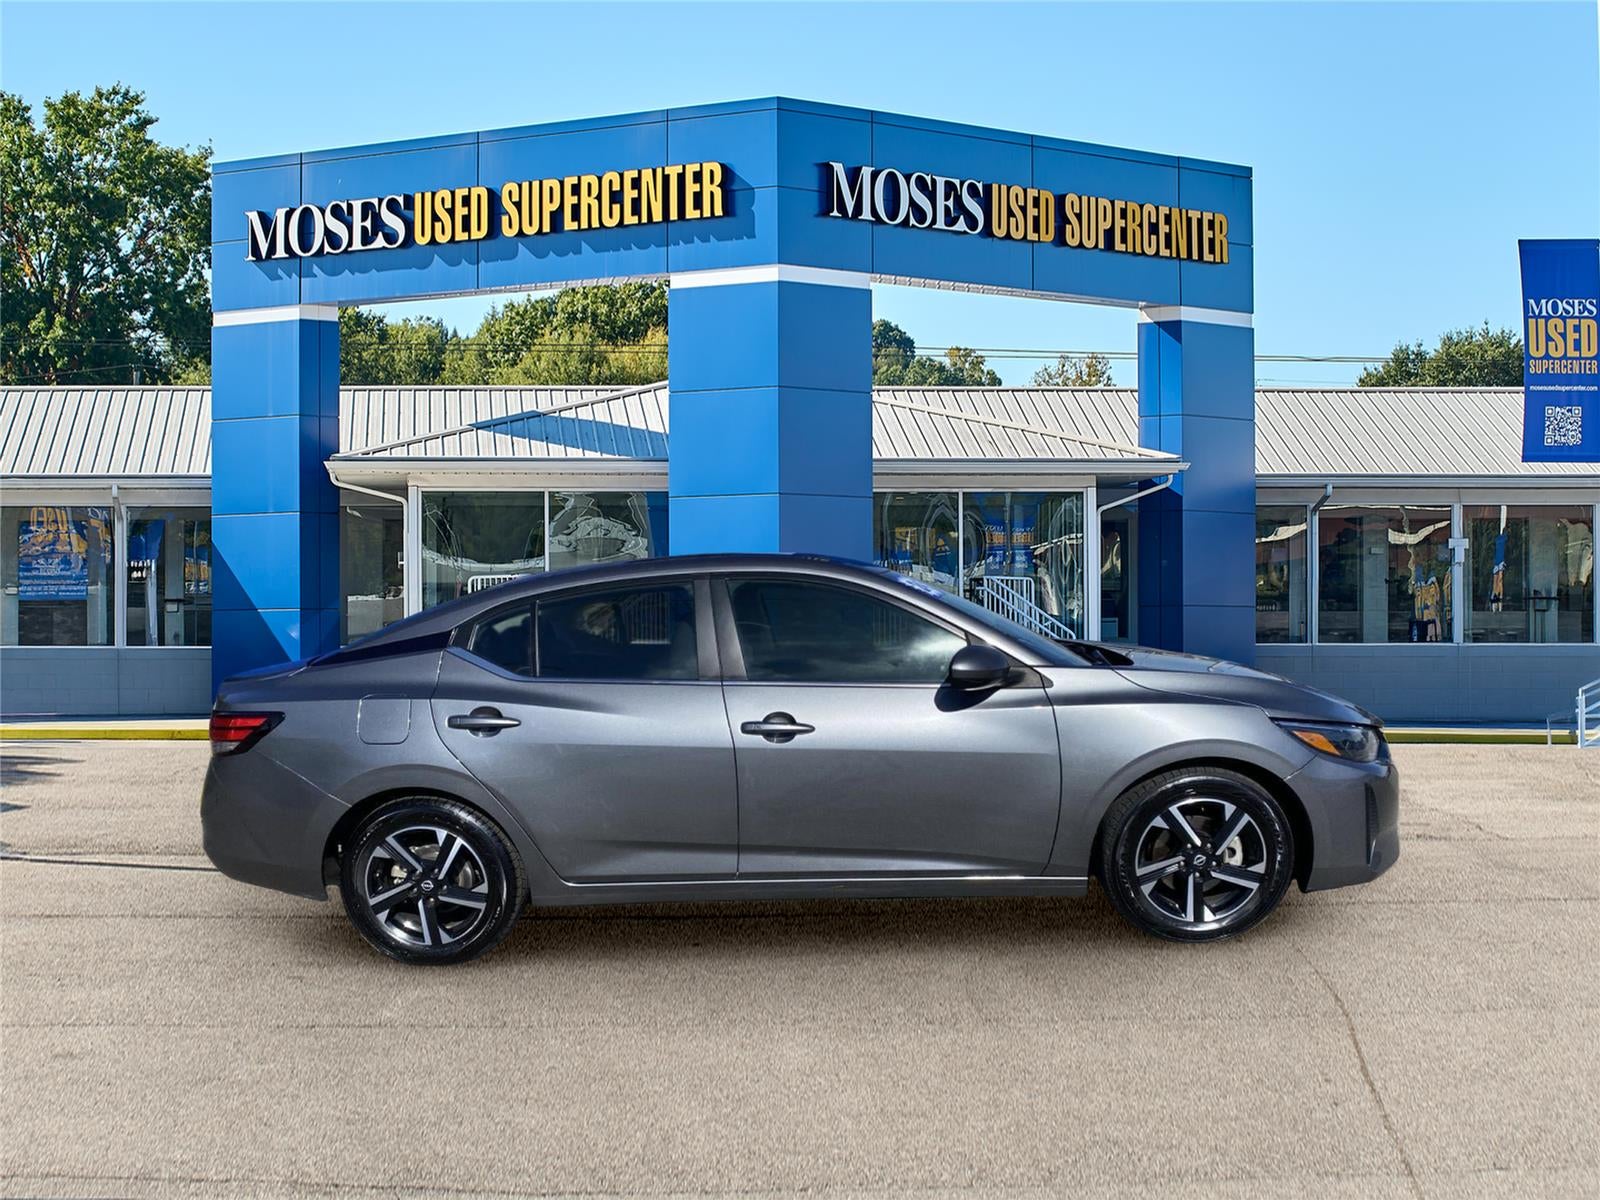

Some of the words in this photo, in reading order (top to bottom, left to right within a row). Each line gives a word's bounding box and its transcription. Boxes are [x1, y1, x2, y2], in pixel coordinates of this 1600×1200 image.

[244, 194, 406, 262] MOSES
[413, 186, 489, 246] USED
[501, 161, 724, 238] SUPERCENTER
[829, 161, 985, 235] MOSES
[991, 183, 1056, 243] USED
[1064, 192, 1230, 264] SUPERCENTER
[1528, 299, 1597, 317] MOSES
[1528, 318, 1598, 358] USED
[1529, 359, 1598, 375] SUPERCENTER
